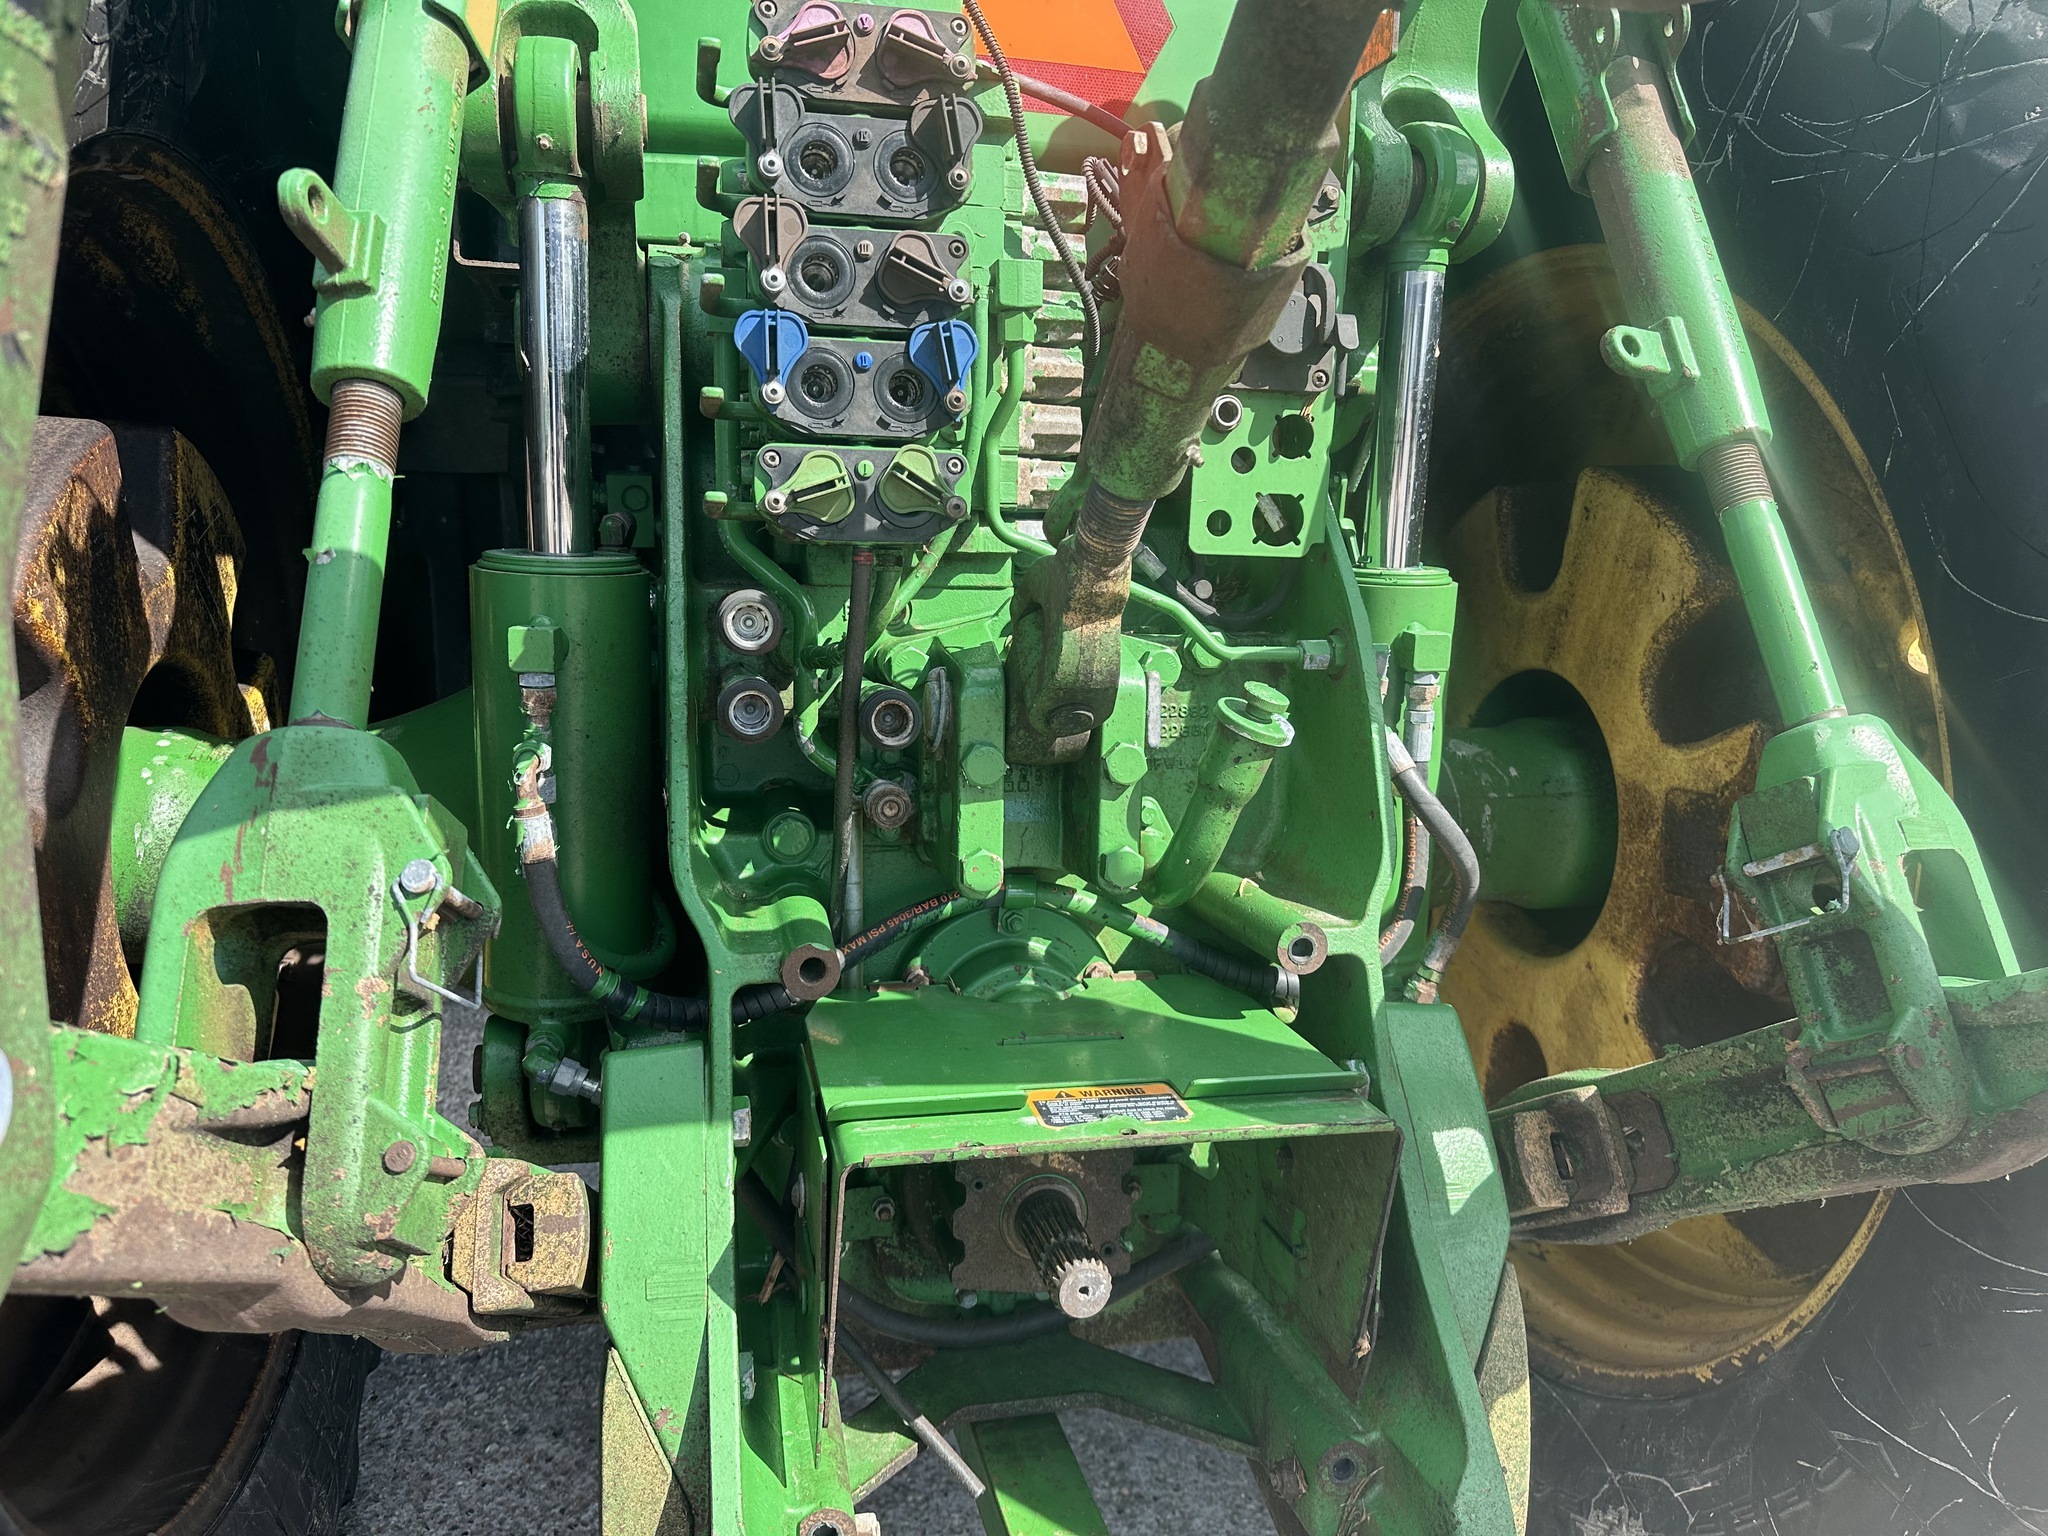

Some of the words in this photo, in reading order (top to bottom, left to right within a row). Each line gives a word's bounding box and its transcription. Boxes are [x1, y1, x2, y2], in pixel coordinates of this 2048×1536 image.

[940, 890, 960, 902] 210
[886, 898, 939, 928] BAR/3045
[867, 924, 887, 940] PSI
[841, 935, 868, 955] MAX
[1079, 1087, 1146, 1097] WARNING
